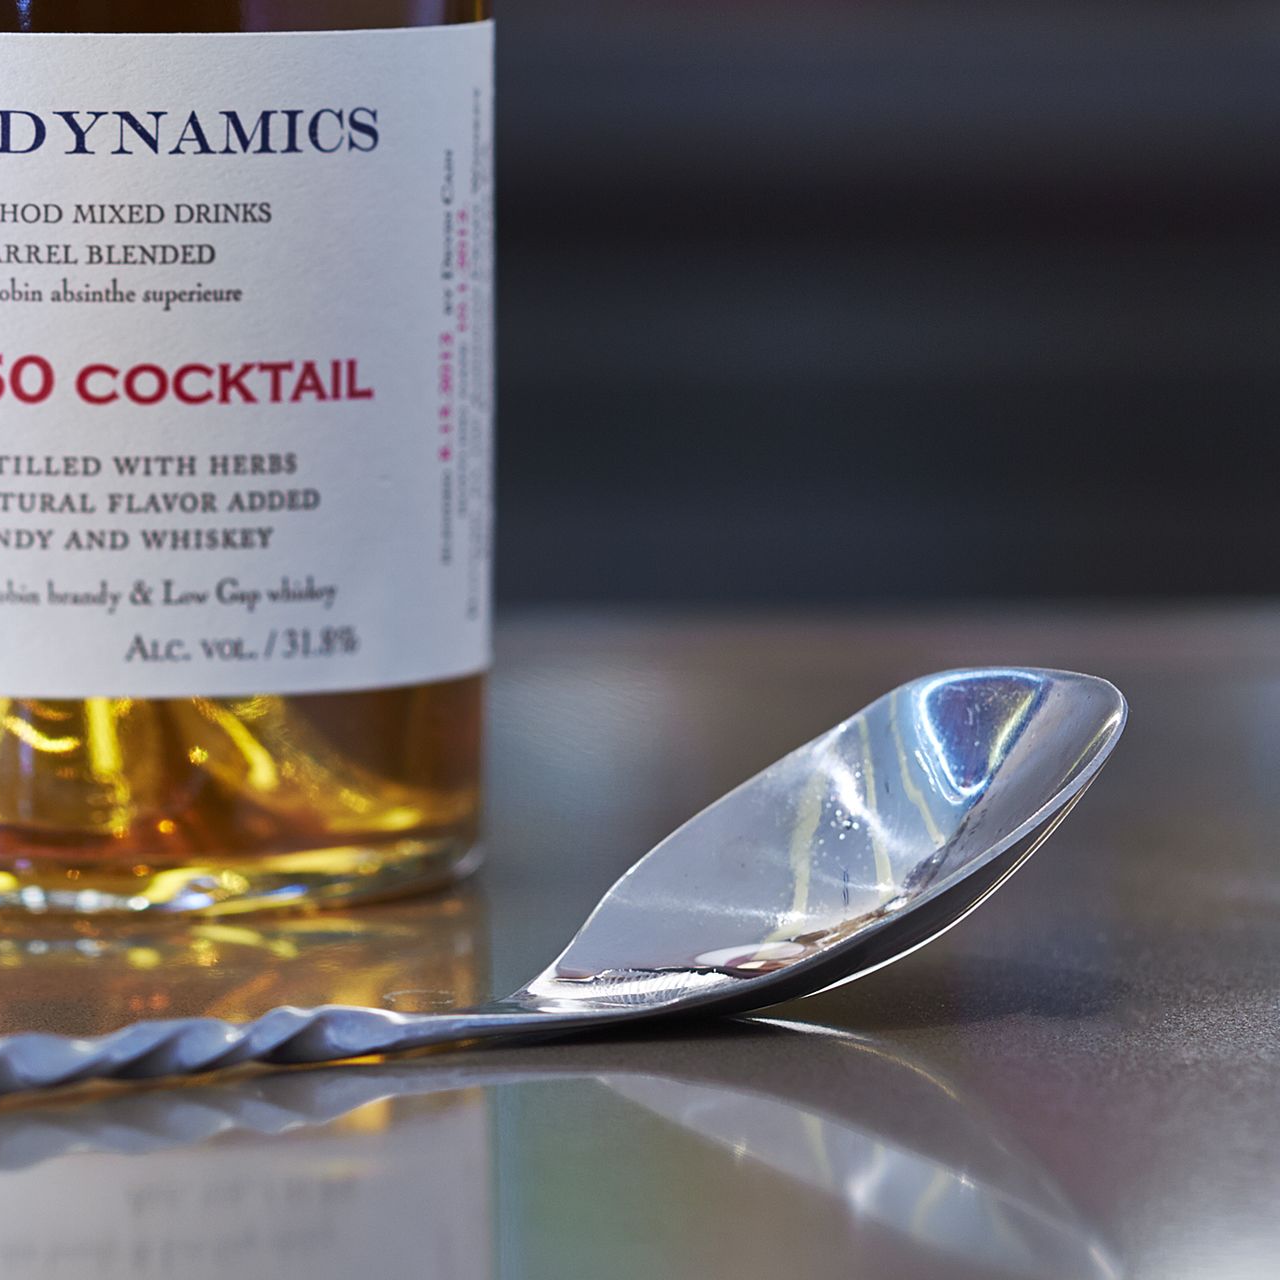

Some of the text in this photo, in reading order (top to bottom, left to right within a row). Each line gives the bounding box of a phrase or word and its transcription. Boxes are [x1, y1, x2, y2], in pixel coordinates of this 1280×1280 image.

[72, 204, 165, 224] MIXED
[174, 202, 272, 224] DRINKS
[86, 244, 216, 265] BLENDED
[51, 277, 136, 303] absinthe
[142, 282, 243, 312] superieure
[75, 359, 374, 405] COCKTAIL
[112, 455, 196, 477] WITH
[209, 452, 297, 476] HERBS
[108, 492, 218, 514] FLAVOR
[226, 488, 321, 513] ADDED
[64, 530, 130, 551] AND
[140, 527, 274, 551] WHISKEY
[46, 579, 122, 615] brandy
[129, 580, 154, 606] &
[162, 579, 209, 606] Low
[216, 577, 262, 613] Gap
